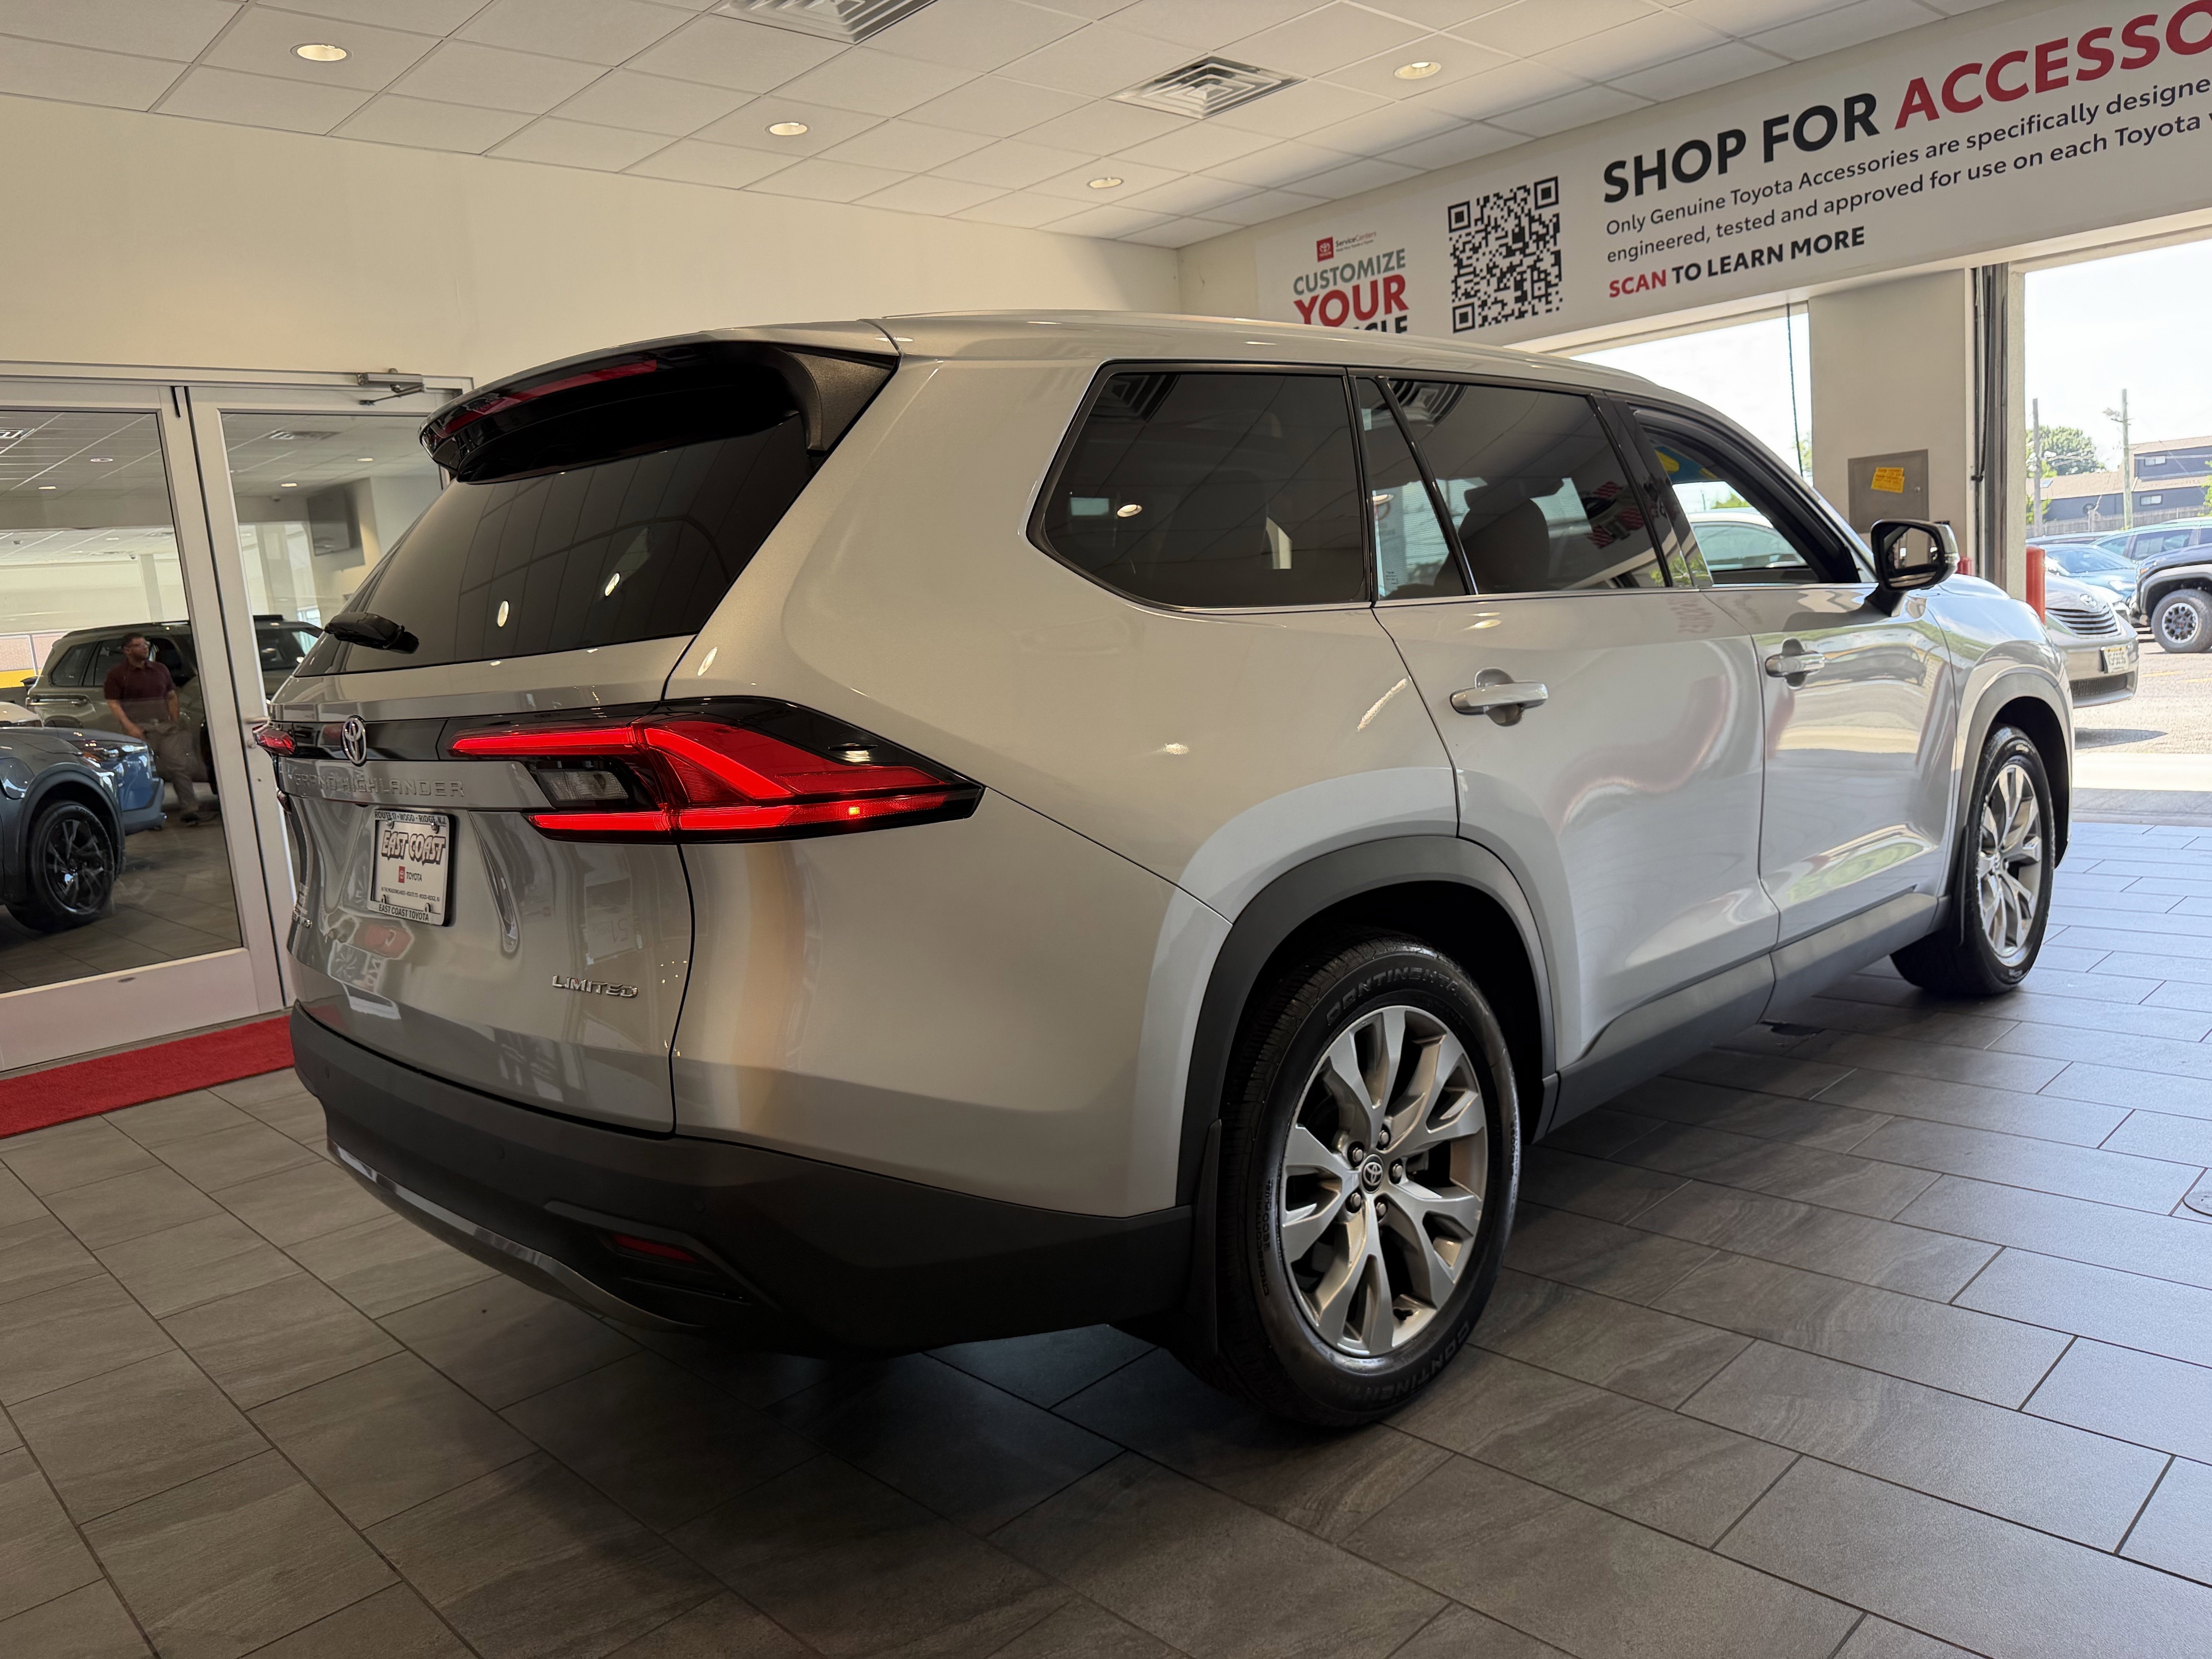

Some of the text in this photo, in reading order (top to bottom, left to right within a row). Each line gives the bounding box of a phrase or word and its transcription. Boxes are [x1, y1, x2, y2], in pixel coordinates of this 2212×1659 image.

[1604, 0, 2212, 203] SHOP FOR ACCESSO
[1607, 79, 2210, 235] Only Genuine Toyota Accessories are specifically designe
[1607, 115, 2201, 263] engineered, tested and approved for use on each Toyota
[1293, 248, 1406, 295] CUSTOMIZE
[1609, 226, 1865, 298] SCAN TO LEARN MORE
[1293, 274, 1409, 328] YOUR
[294, 773, 465, 797] GRAND HIGHLANDER
[374, 811, 391, 820] ROUTE
[398, 813, 414, 822] WOOD
[381, 830, 446, 866] EAST COAST
[406, 871, 422, 881] TOYOTA
[379, 904, 429, 921] EAST COAST TOYOTA
[552, 975, 639, 998] LIMITED
[1326, 967, 1470, 1027] CONTINENTAL
